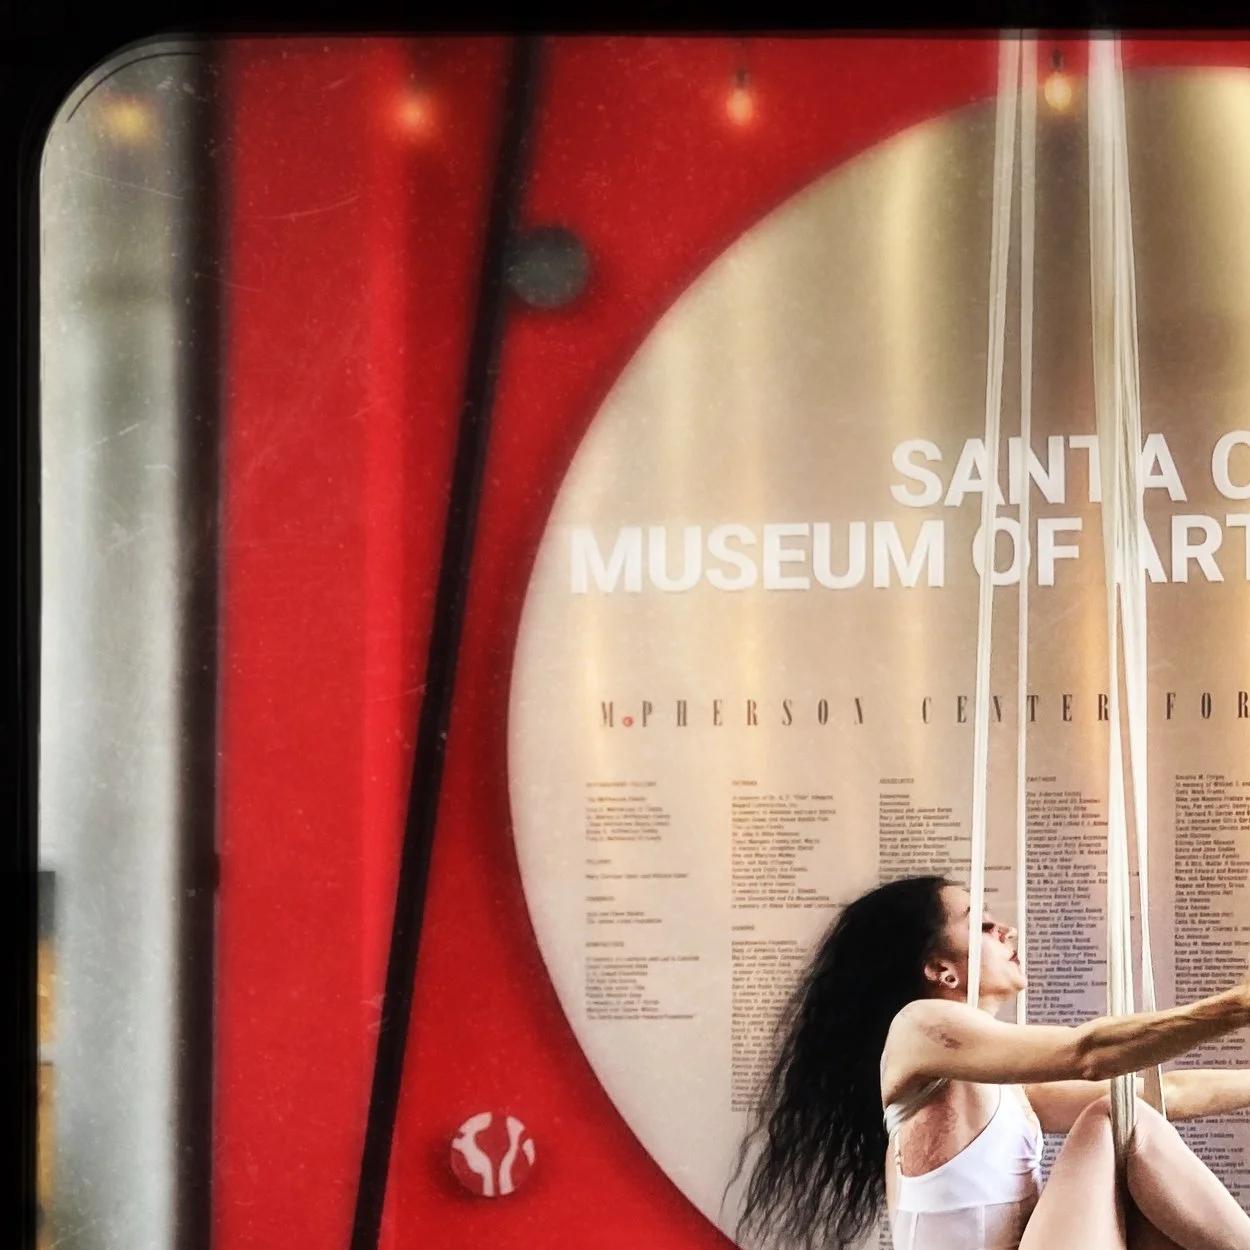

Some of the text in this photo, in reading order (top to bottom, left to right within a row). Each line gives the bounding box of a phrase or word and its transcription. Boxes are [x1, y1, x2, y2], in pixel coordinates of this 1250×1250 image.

[890, 433, 1187, 508] SANTA
[570, 519, 945, 595] MUSEUM
[972, 517, 1082, 587] OF
[922, 693, 1109, 724] CENTER
[1166, 691, 1249, 720] FOR
